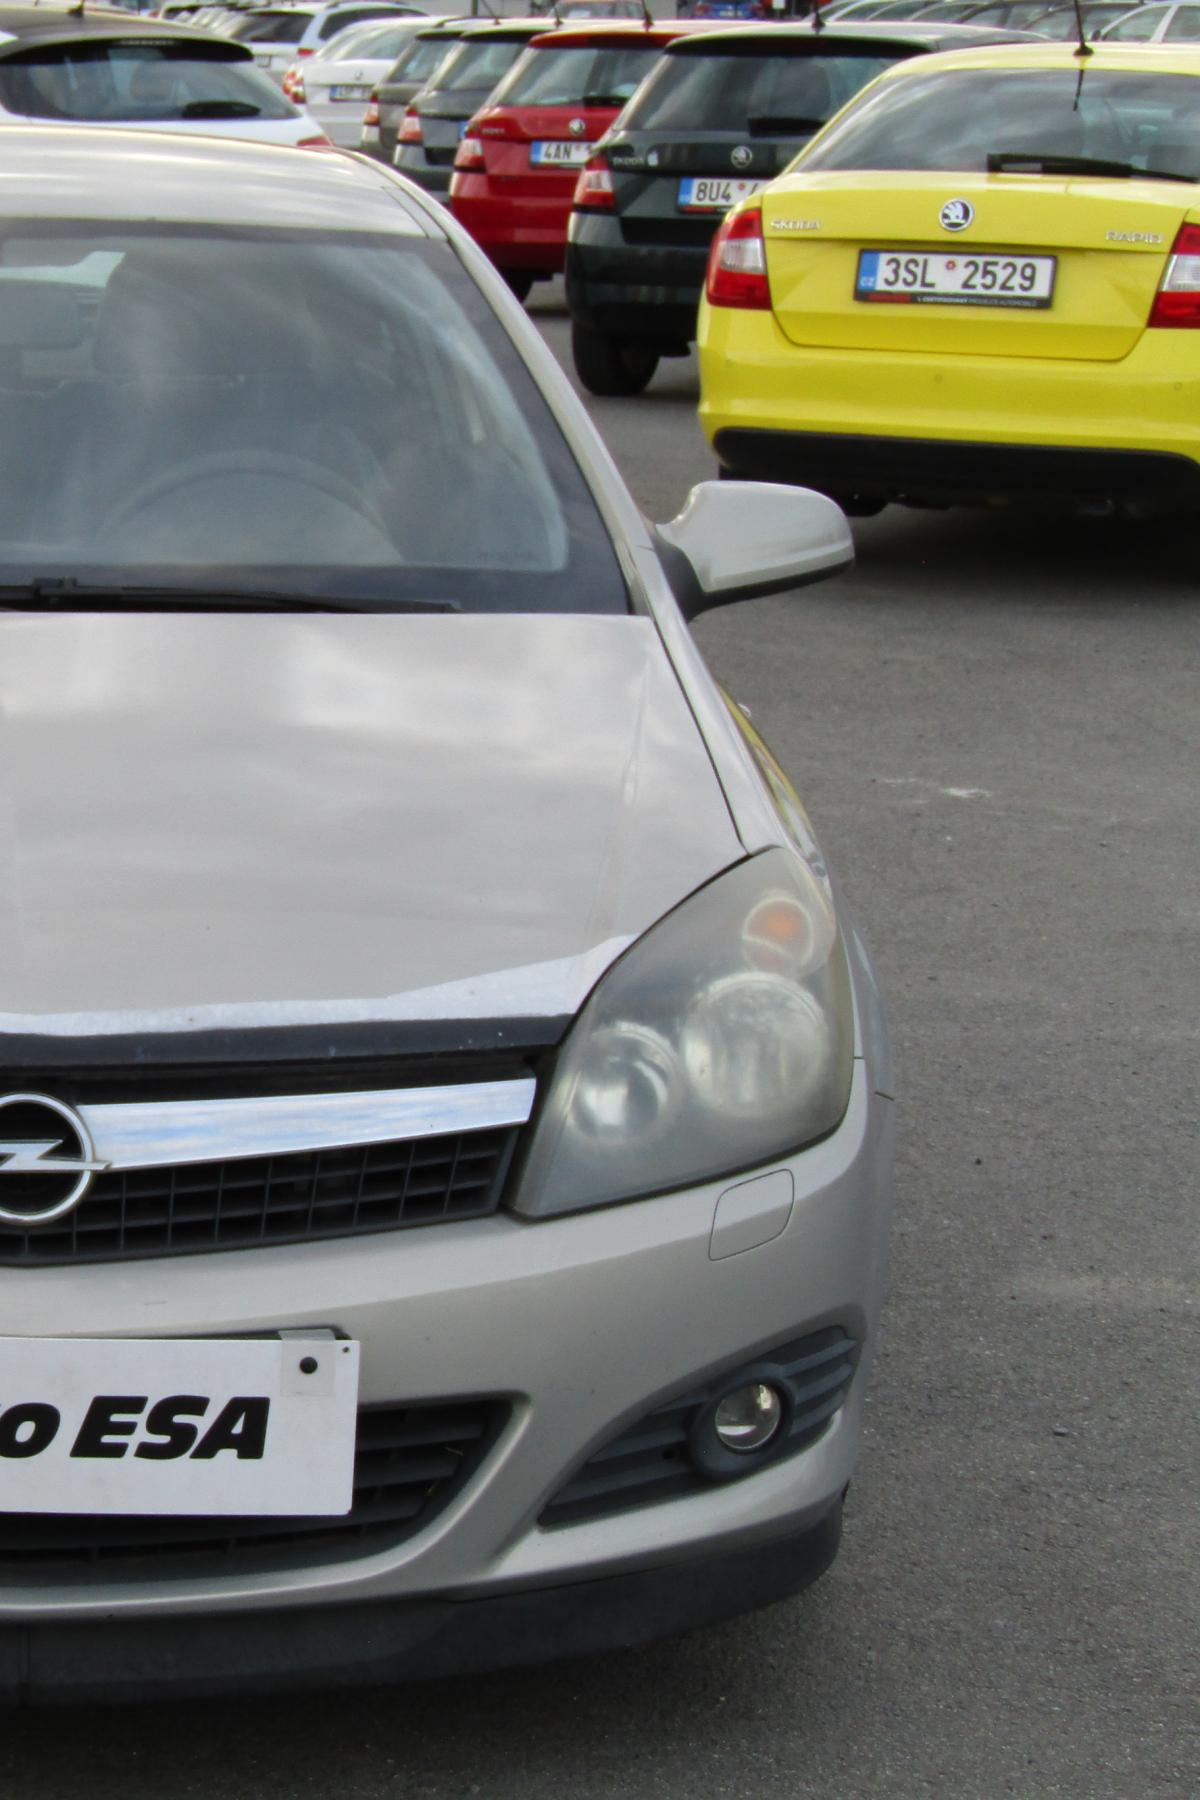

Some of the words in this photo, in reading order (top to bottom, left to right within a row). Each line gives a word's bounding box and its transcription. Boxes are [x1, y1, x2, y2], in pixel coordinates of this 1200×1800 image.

[695, 181, 732, 202] 8U4
[883, 257, 936, 288] 3SL
[961, 260, 1037, 292] 2529
[69, 1395, 271, 1460] ESA
